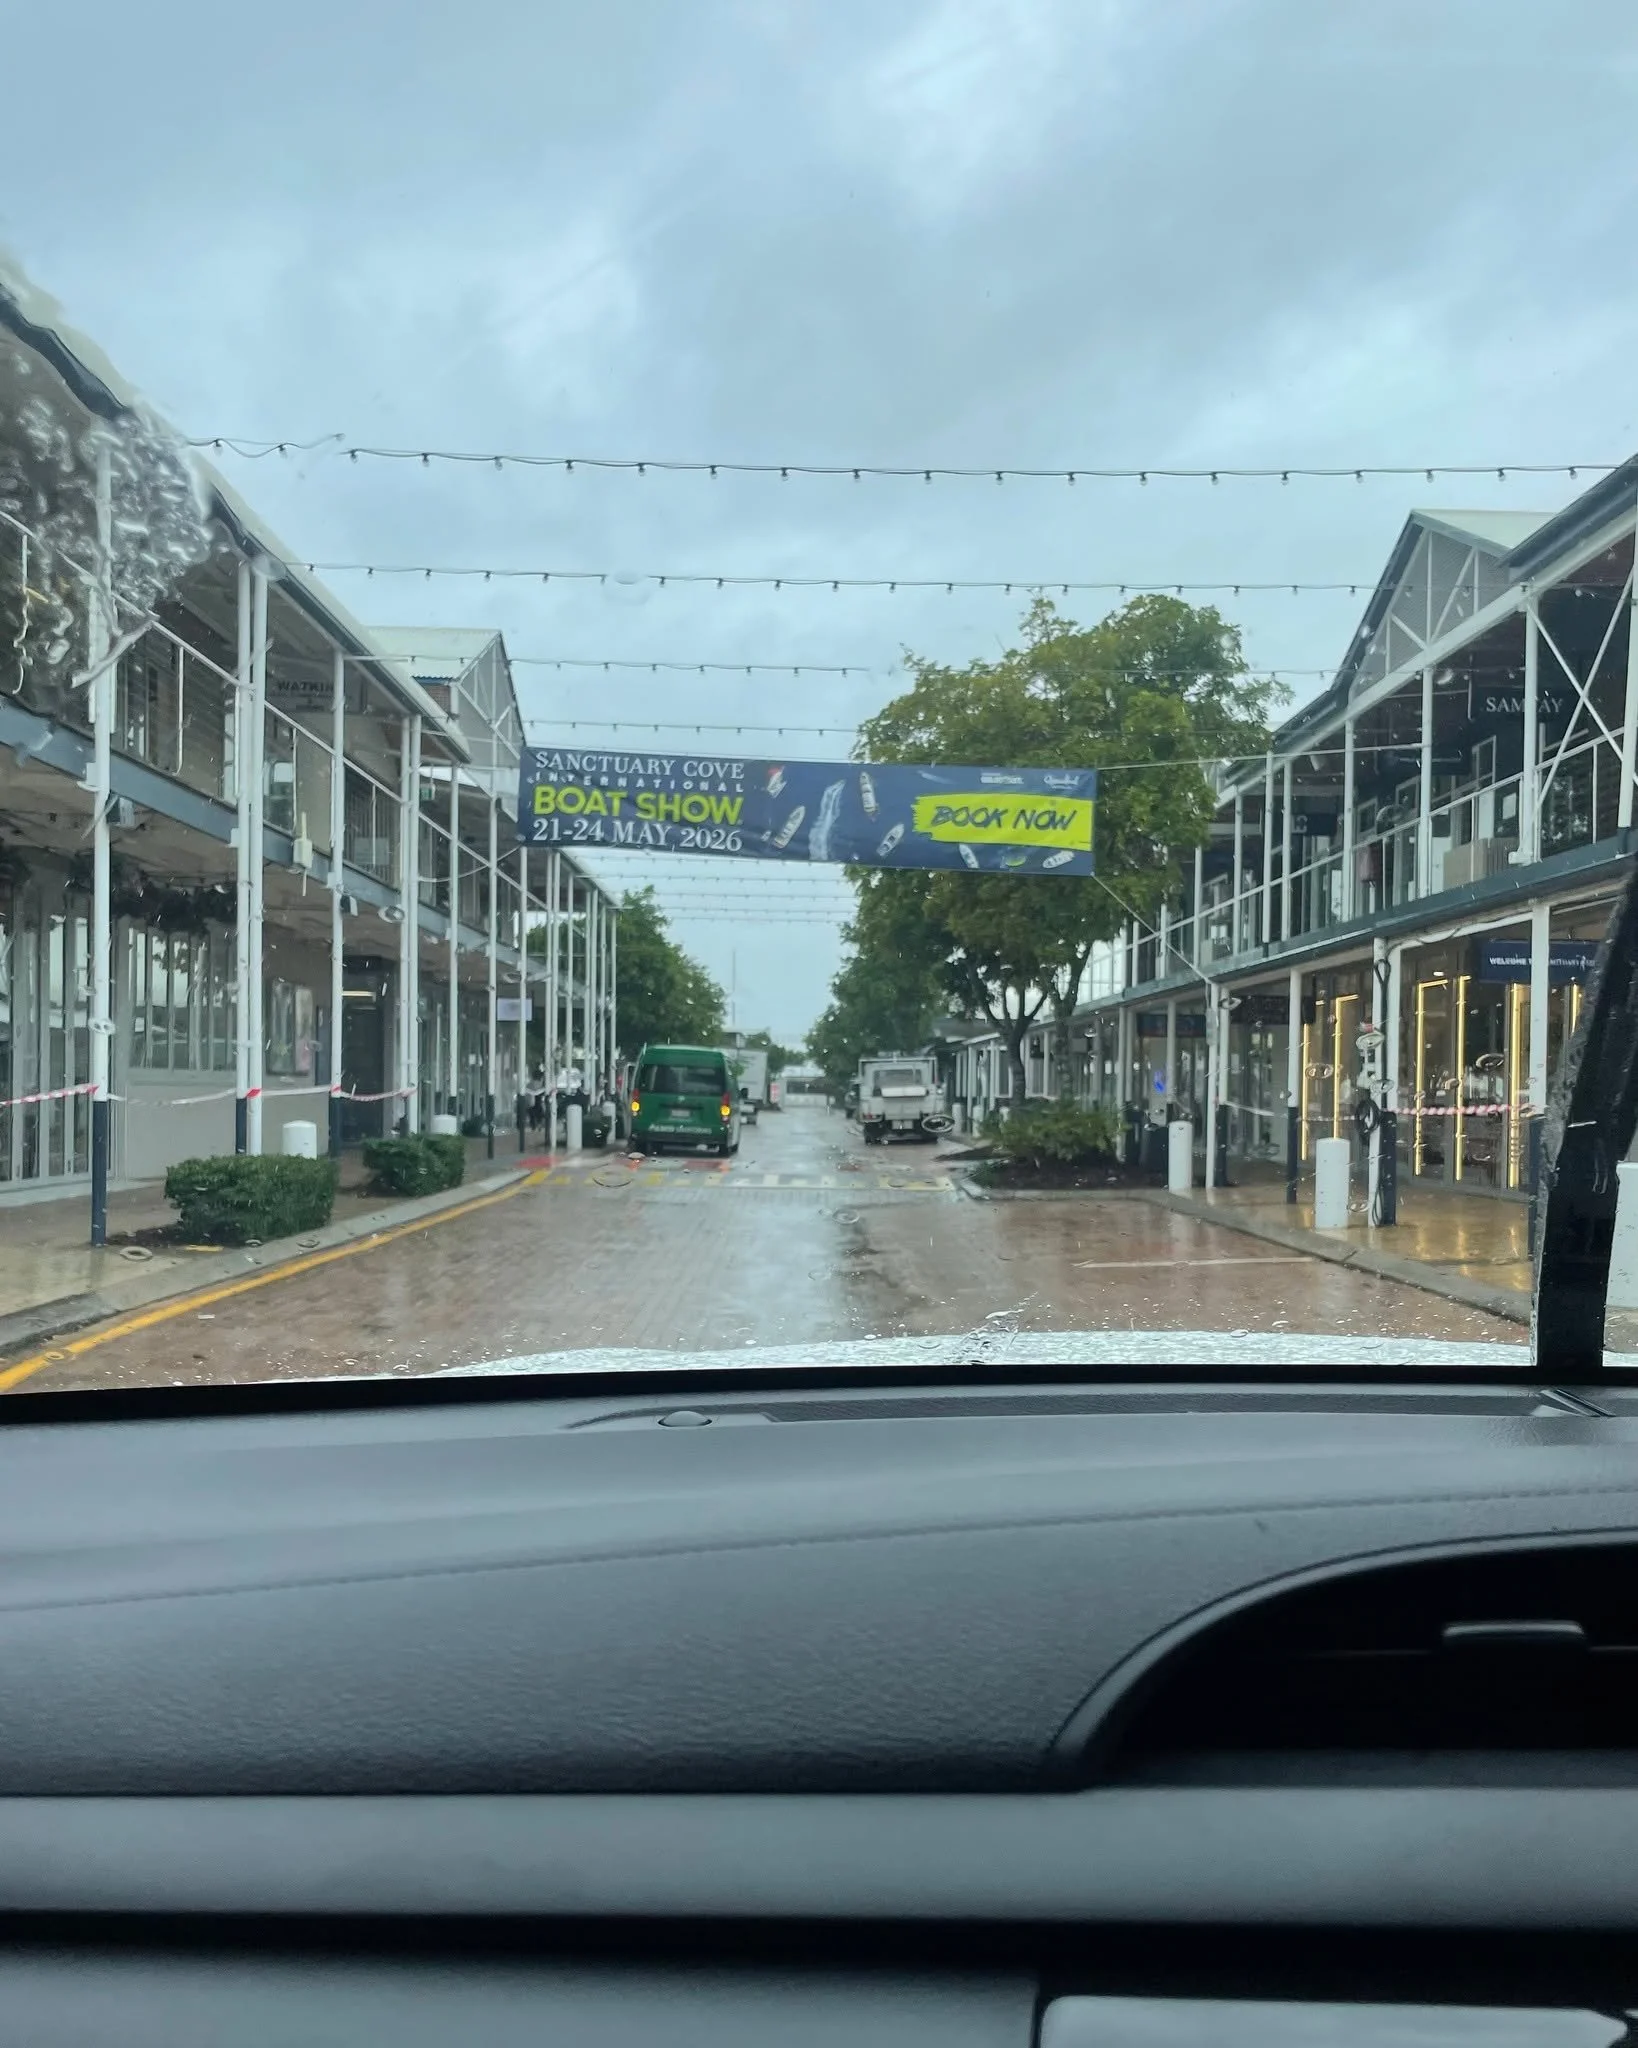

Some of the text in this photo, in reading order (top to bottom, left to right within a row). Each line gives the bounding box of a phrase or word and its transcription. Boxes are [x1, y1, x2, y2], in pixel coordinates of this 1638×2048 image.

[1486, 696, 1563, 713] SAMAY
[535, 750, 745, 779] SANCTUARY COVE
[535, 771, 744, 793] INTERNATIONAL
[533, 784, 744, 826] BOAT SHOW
[931, 805, 1078, 831] BOOK NOW
[532, 817, 743, 852] 21-24 MAY 2026
